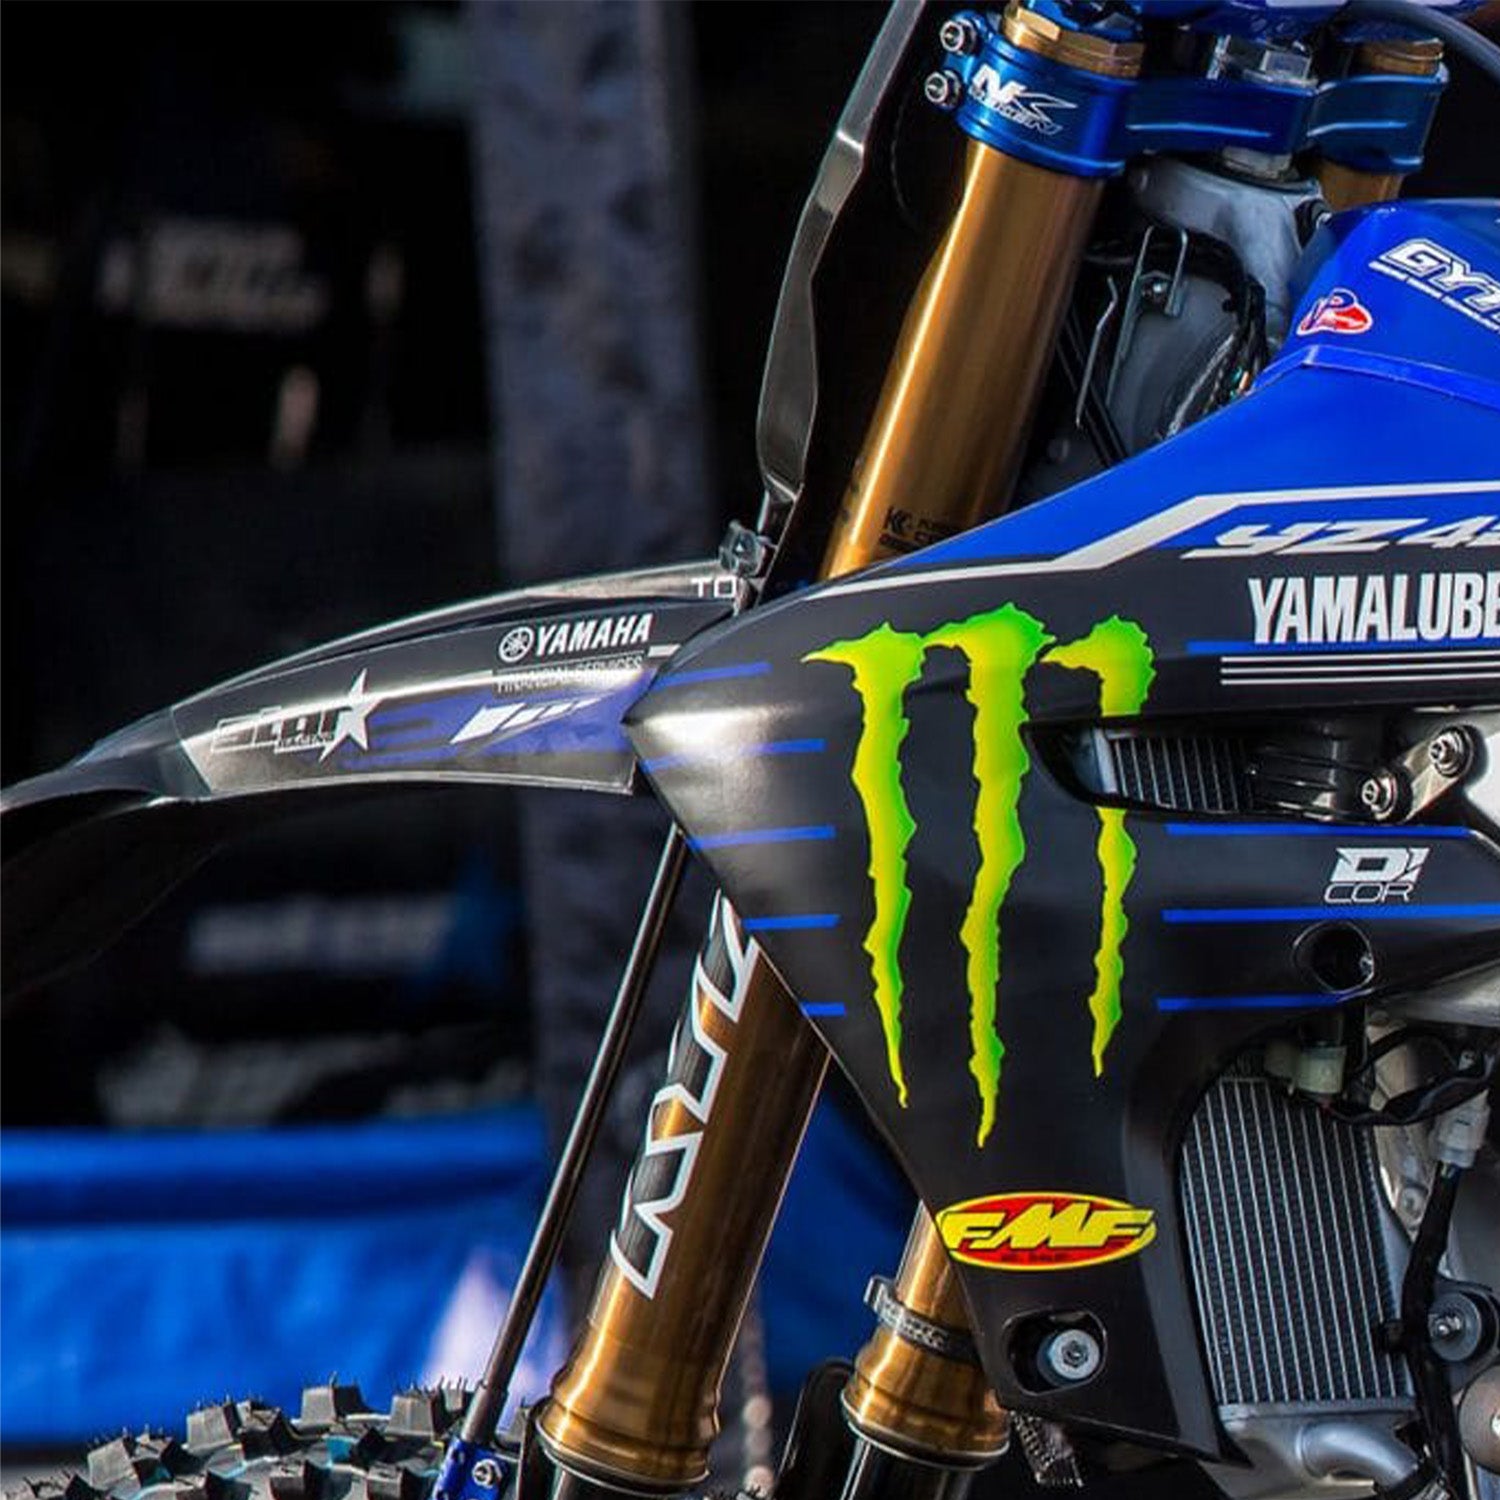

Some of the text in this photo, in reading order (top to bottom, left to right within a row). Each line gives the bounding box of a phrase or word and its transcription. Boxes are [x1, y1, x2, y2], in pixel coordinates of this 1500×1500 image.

[536, 613, 655, 657] YAMAHA
[1324, 882, 1415, 904] COR
[940, 1201, 1156, 1250] FMF
